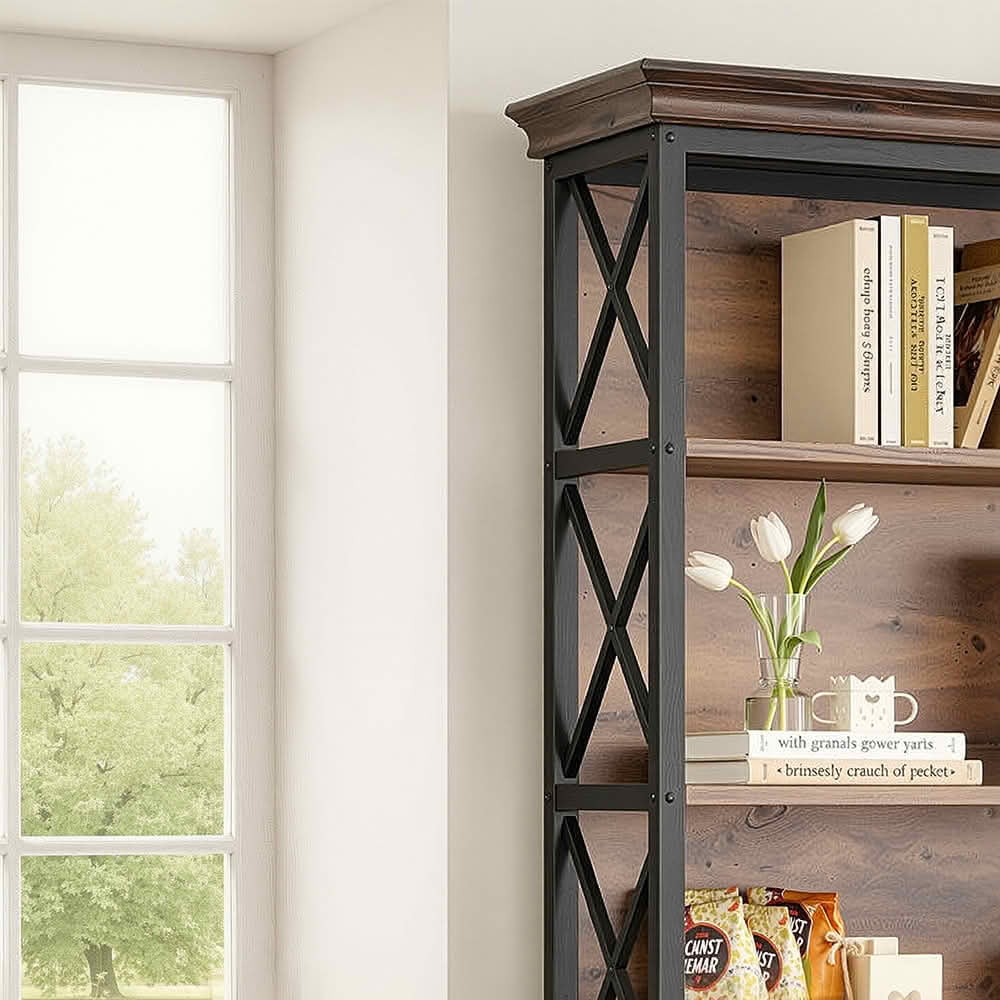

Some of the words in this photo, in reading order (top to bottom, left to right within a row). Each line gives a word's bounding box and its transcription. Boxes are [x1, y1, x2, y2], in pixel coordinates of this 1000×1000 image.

[778, 735, 806, 749] with
[810, 736, 857, 752] granals
[861, 739, 900, 752] gower
[785, 763, 843, 780] brinsesly
[847, 763, 889, 777] crauch
[893, 763, 907, 777] of
